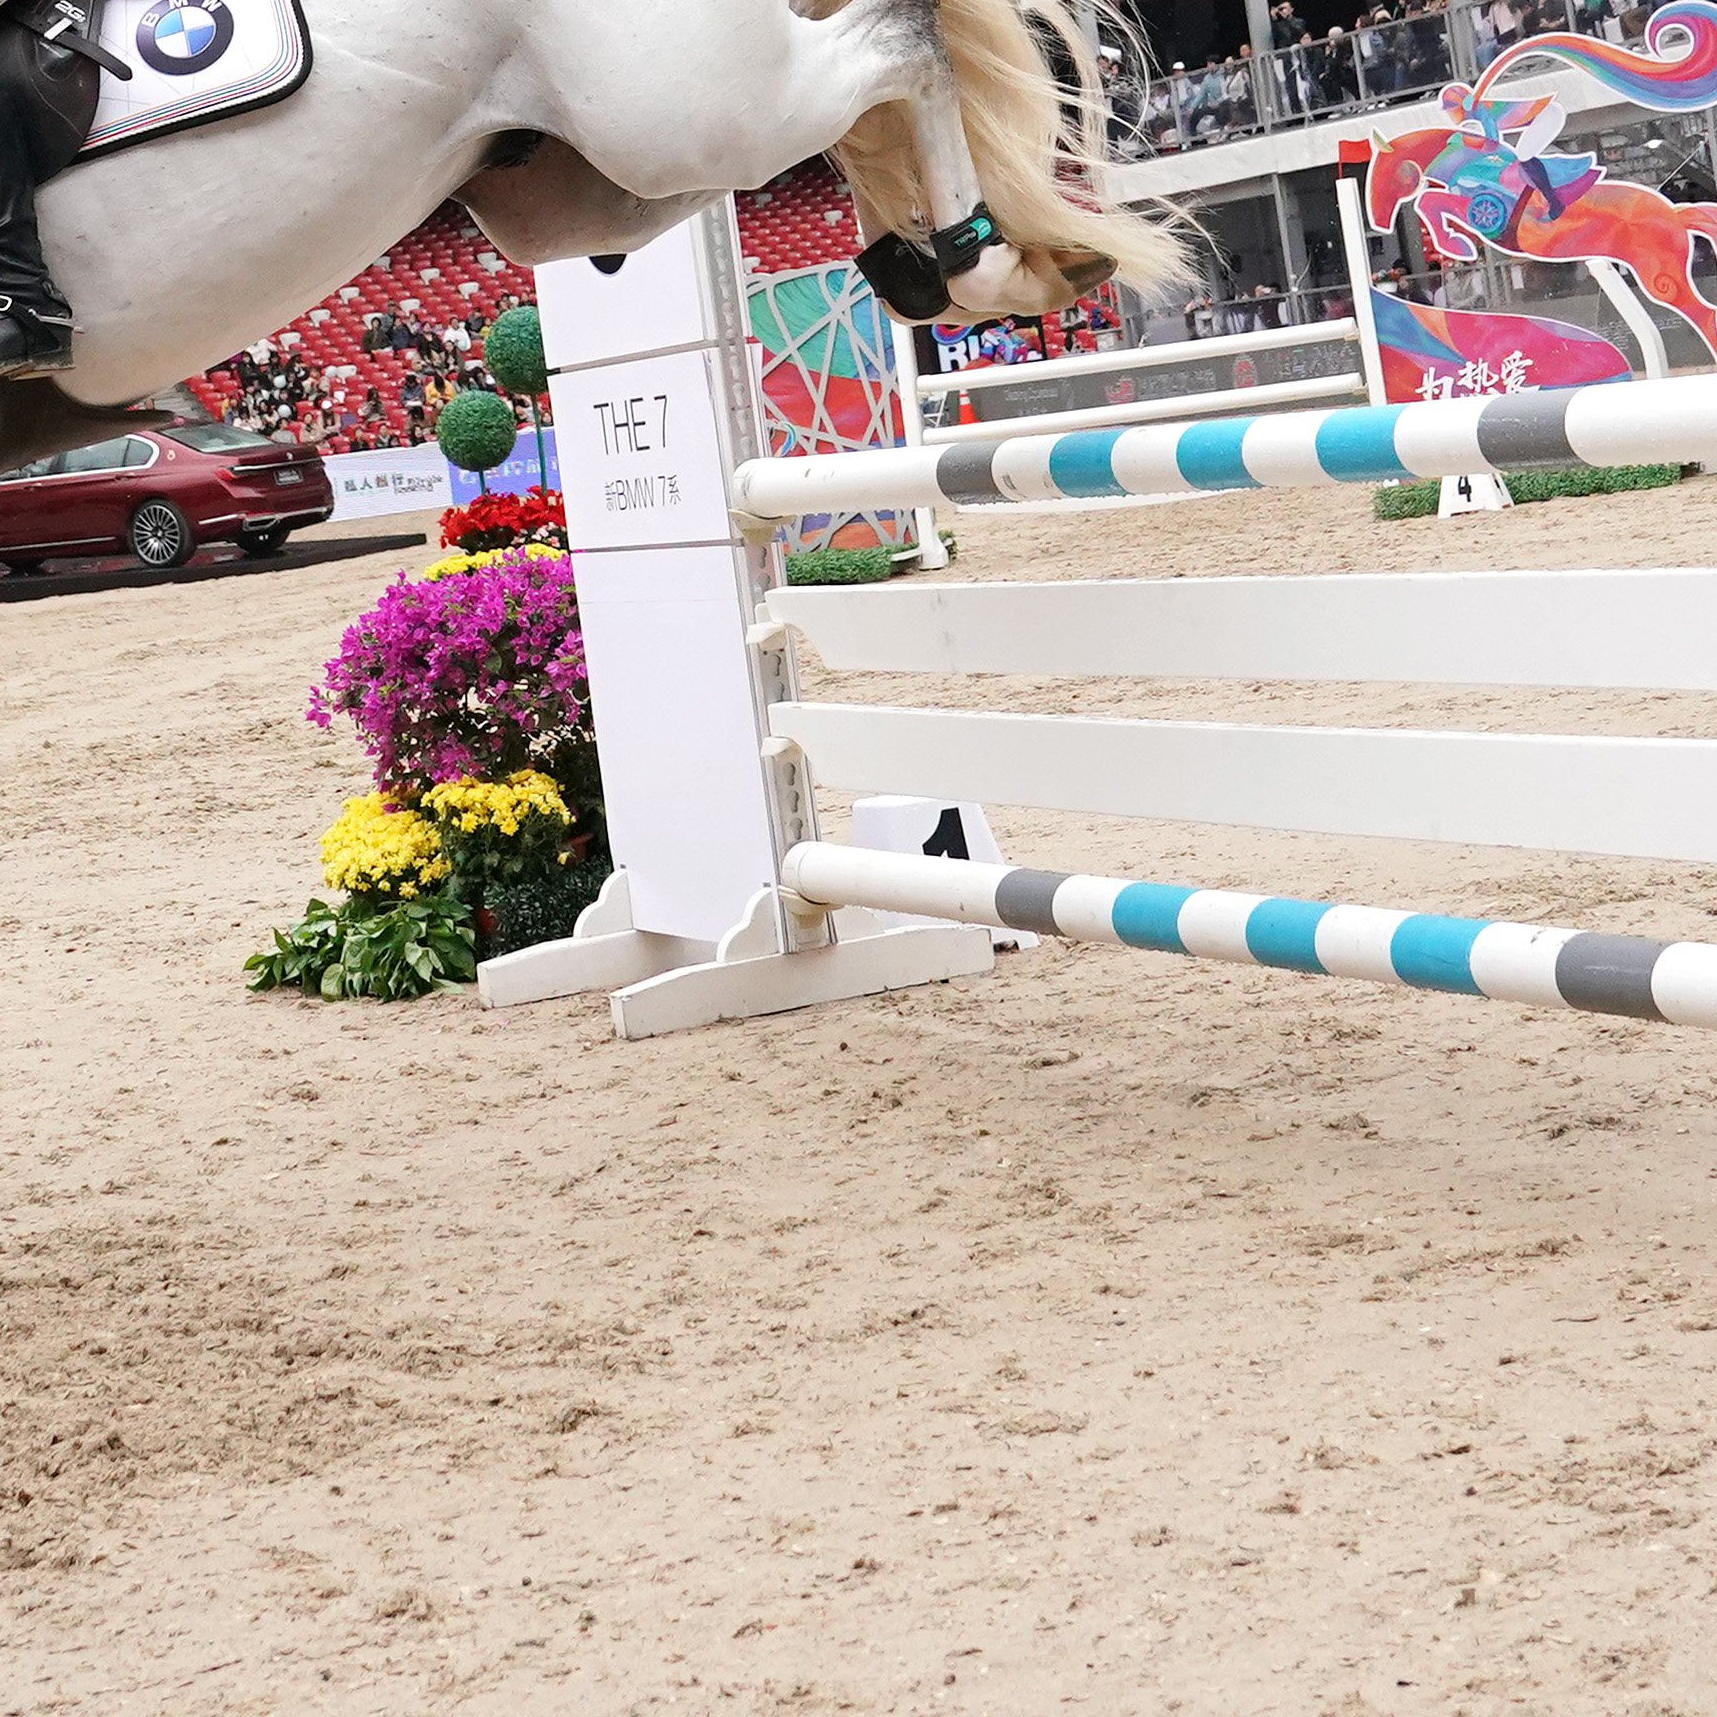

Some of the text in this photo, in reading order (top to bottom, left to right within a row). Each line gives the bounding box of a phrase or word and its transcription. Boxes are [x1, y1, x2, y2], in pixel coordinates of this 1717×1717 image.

[593, 395, 667, 456] THE 7
[605, 475, 682, 512] 新BMW 7系
[1458, 475, 1472, 502] 4
